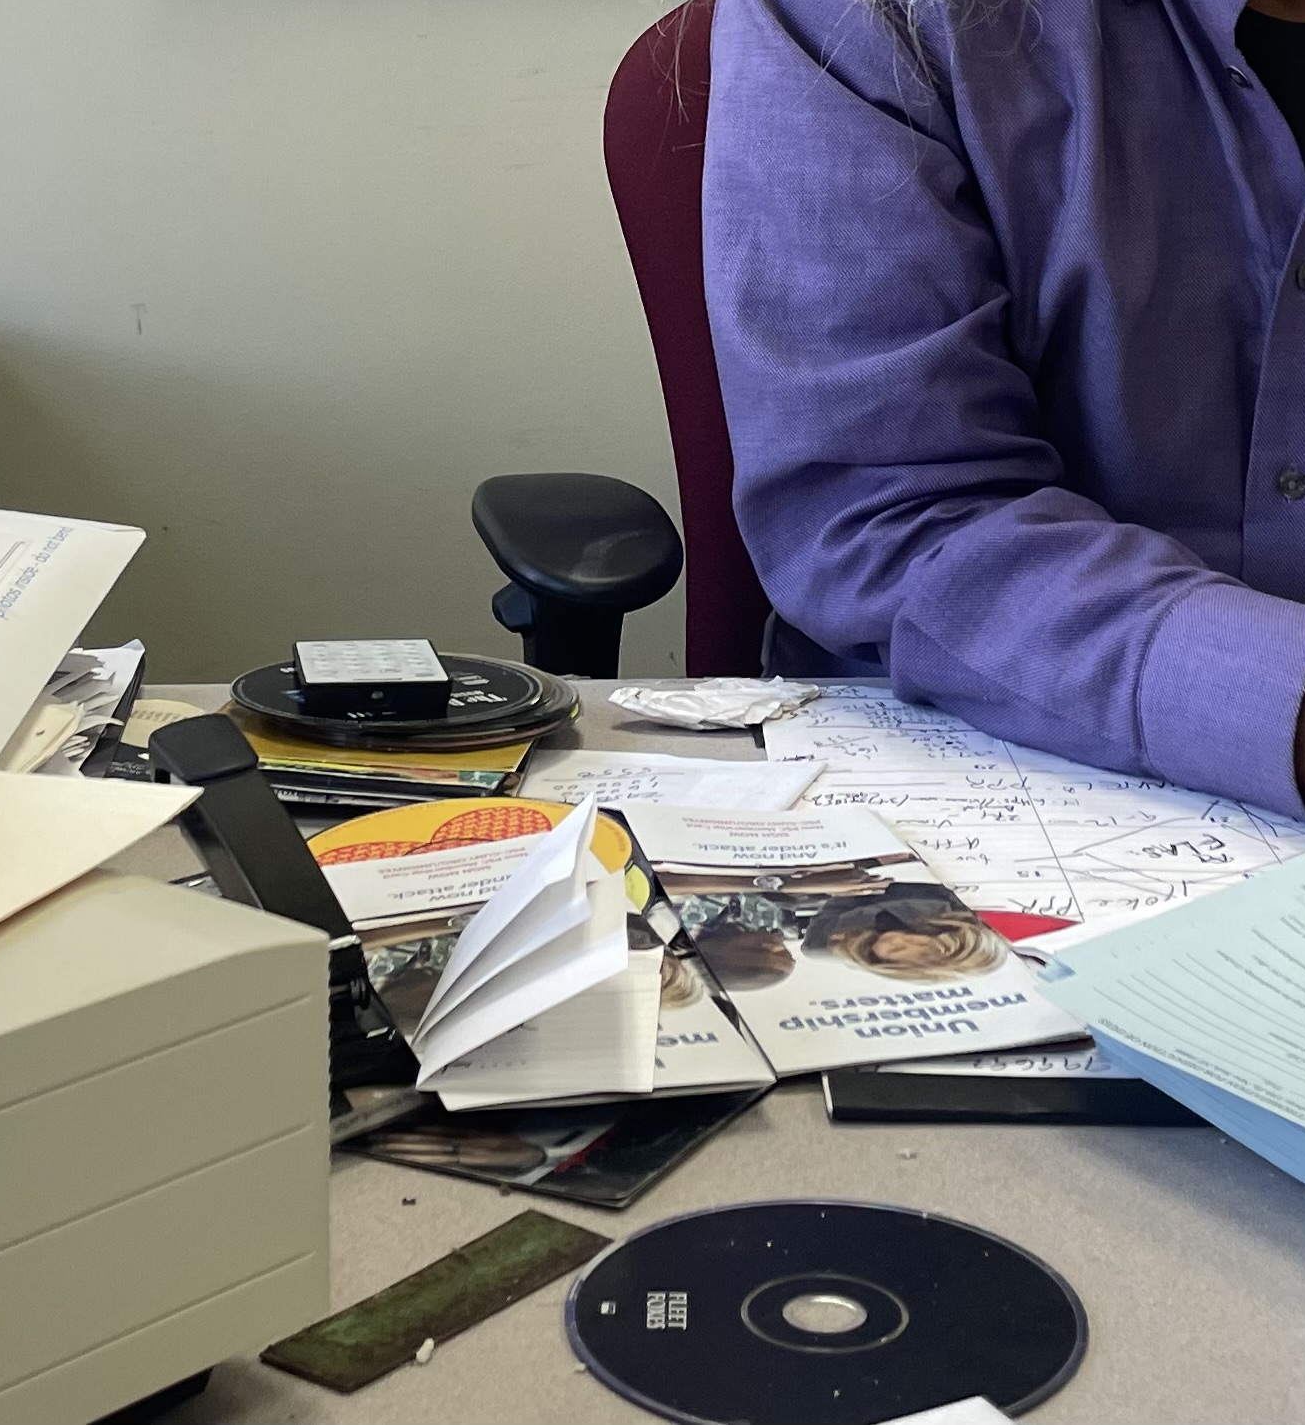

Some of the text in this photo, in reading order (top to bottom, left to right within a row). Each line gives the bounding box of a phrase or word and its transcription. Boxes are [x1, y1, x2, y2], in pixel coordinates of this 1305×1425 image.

[732, 851, 818, 861] And now
[760, 843, 817, 853] under
[429, 889, 473, 903] now
[808, 986, 974, 1011] matters.
[778, 991, 1028, 1032] membership
[854, 1018, 981, 1039] Union
[646, 1291, 667, 1331] FOXES
[668, 1291, 688, 1331] FLEET
